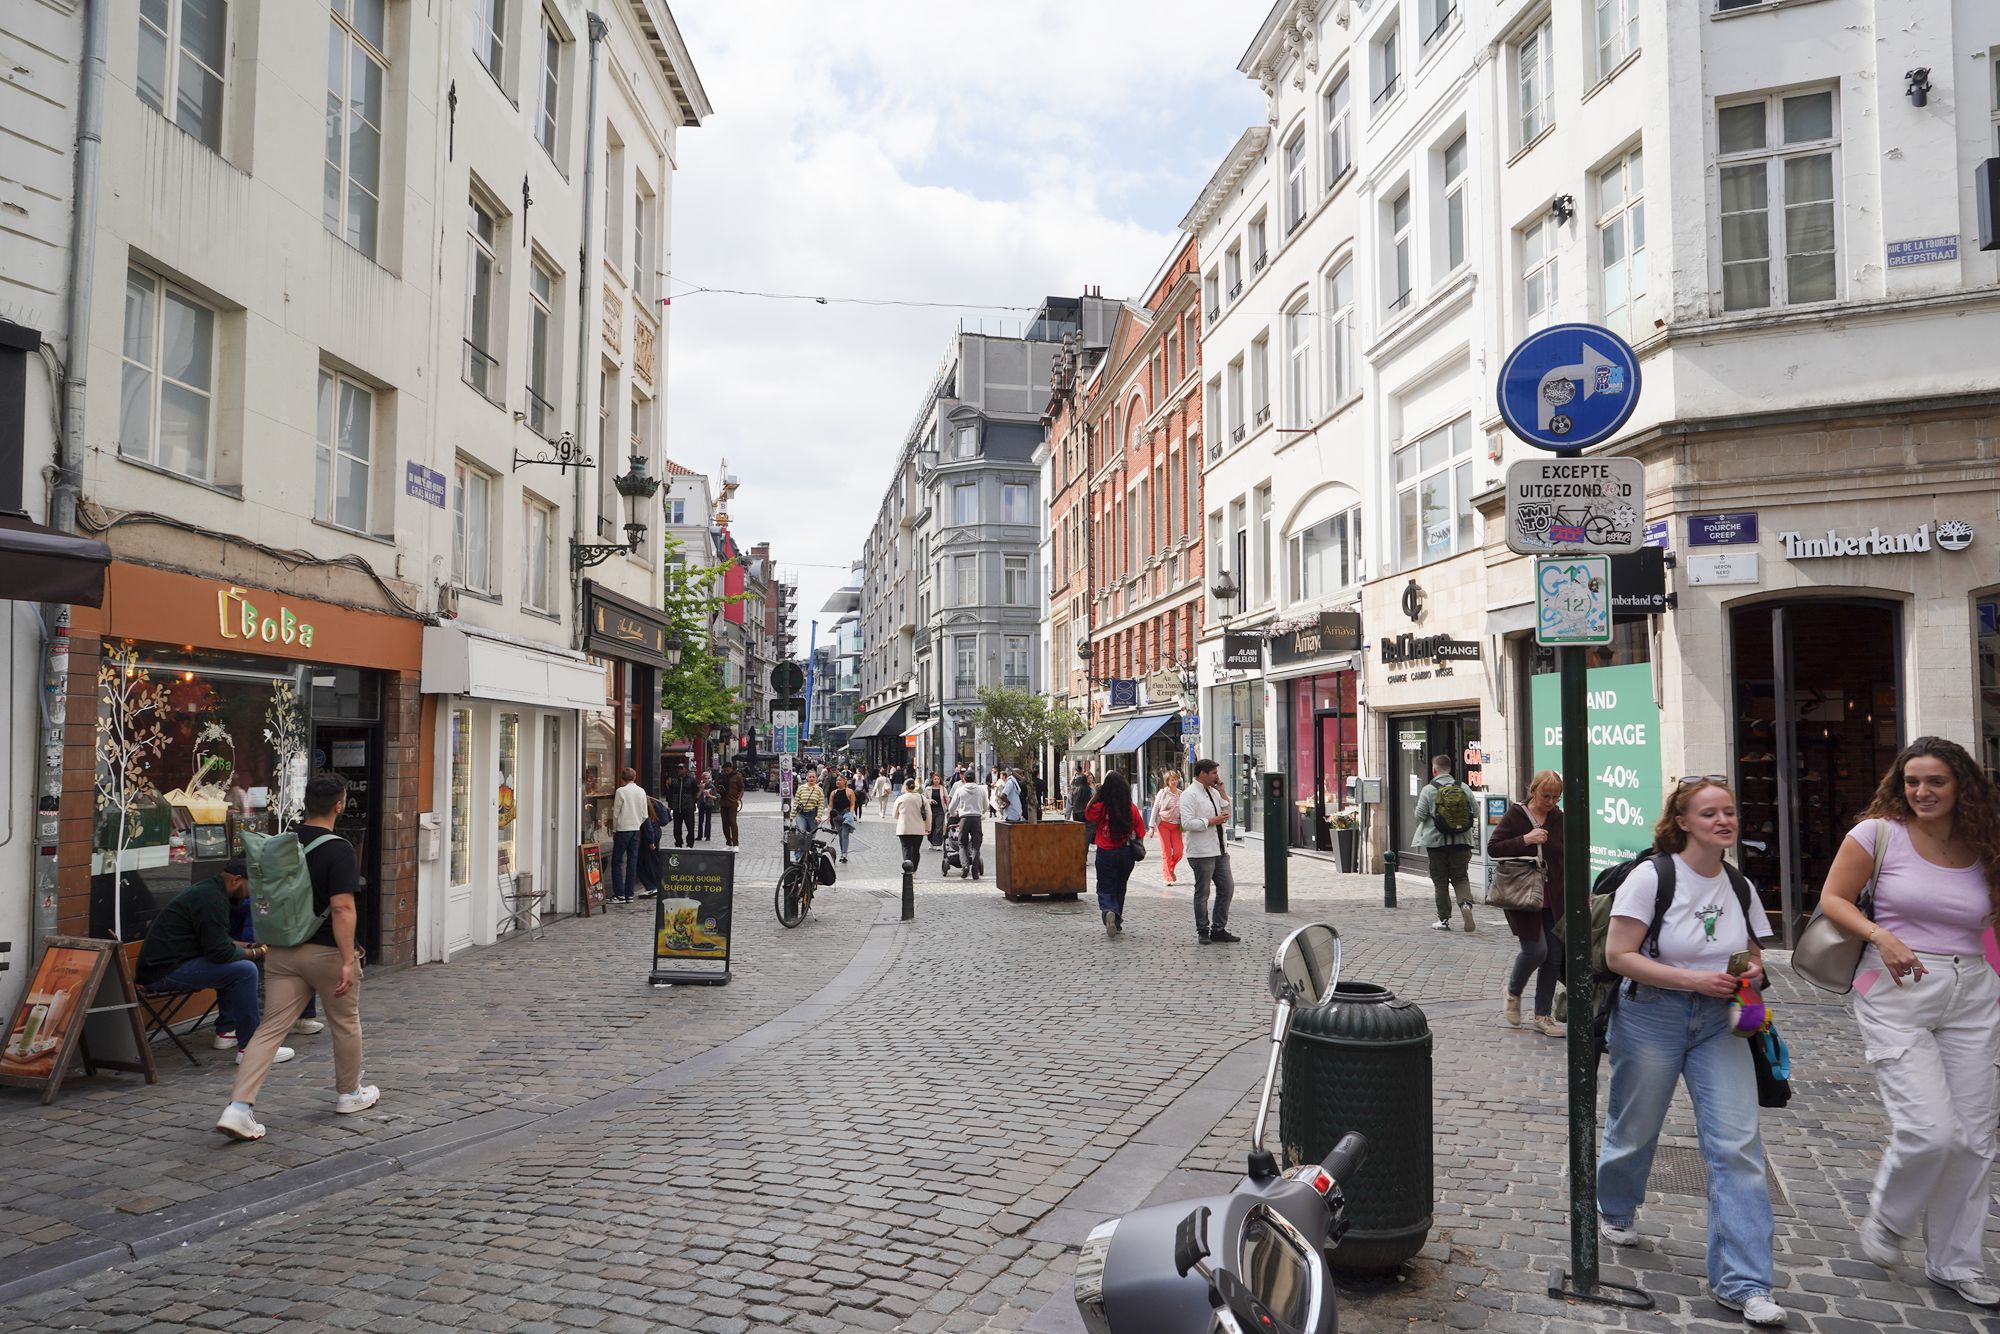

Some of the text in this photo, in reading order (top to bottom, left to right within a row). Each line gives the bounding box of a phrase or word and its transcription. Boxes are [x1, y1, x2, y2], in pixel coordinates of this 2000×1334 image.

[1888, 237, 1957, 253] RUE DE LA FOURCHE
[1889, 249, 1955, 266] GREEPSTRAAT
[560, 441, 570, 460] 9
[1542, 465, 1609, 479] EXCEPTE
[1520, 483, 1632, 498] UITGEZONDD
[1704, 523, 1741, 532] FOURCHE
[1709, 531, 1736, 540] GREEP
[1779, 524, 1931, 559] Timberland
[1564, 598, 1584, 612] 12
[1612, 594, 1651, 606] mberland
[1324, 625, 1356, 637] Amaya
[1438, 645, 1478, 656] CHANGE
[1227, 655, 1257, 663] AFFLELOU
[1388, 667, 1454, 684] CHANGE CAMBIO WISSEL
[1596, 766, 1640, 789] -40%
[1596, 798, 1644, 826] -50%
[670, 874, 721, 883] BLACK SUGAR
[664, 884, 701, 892] BUBBLE
